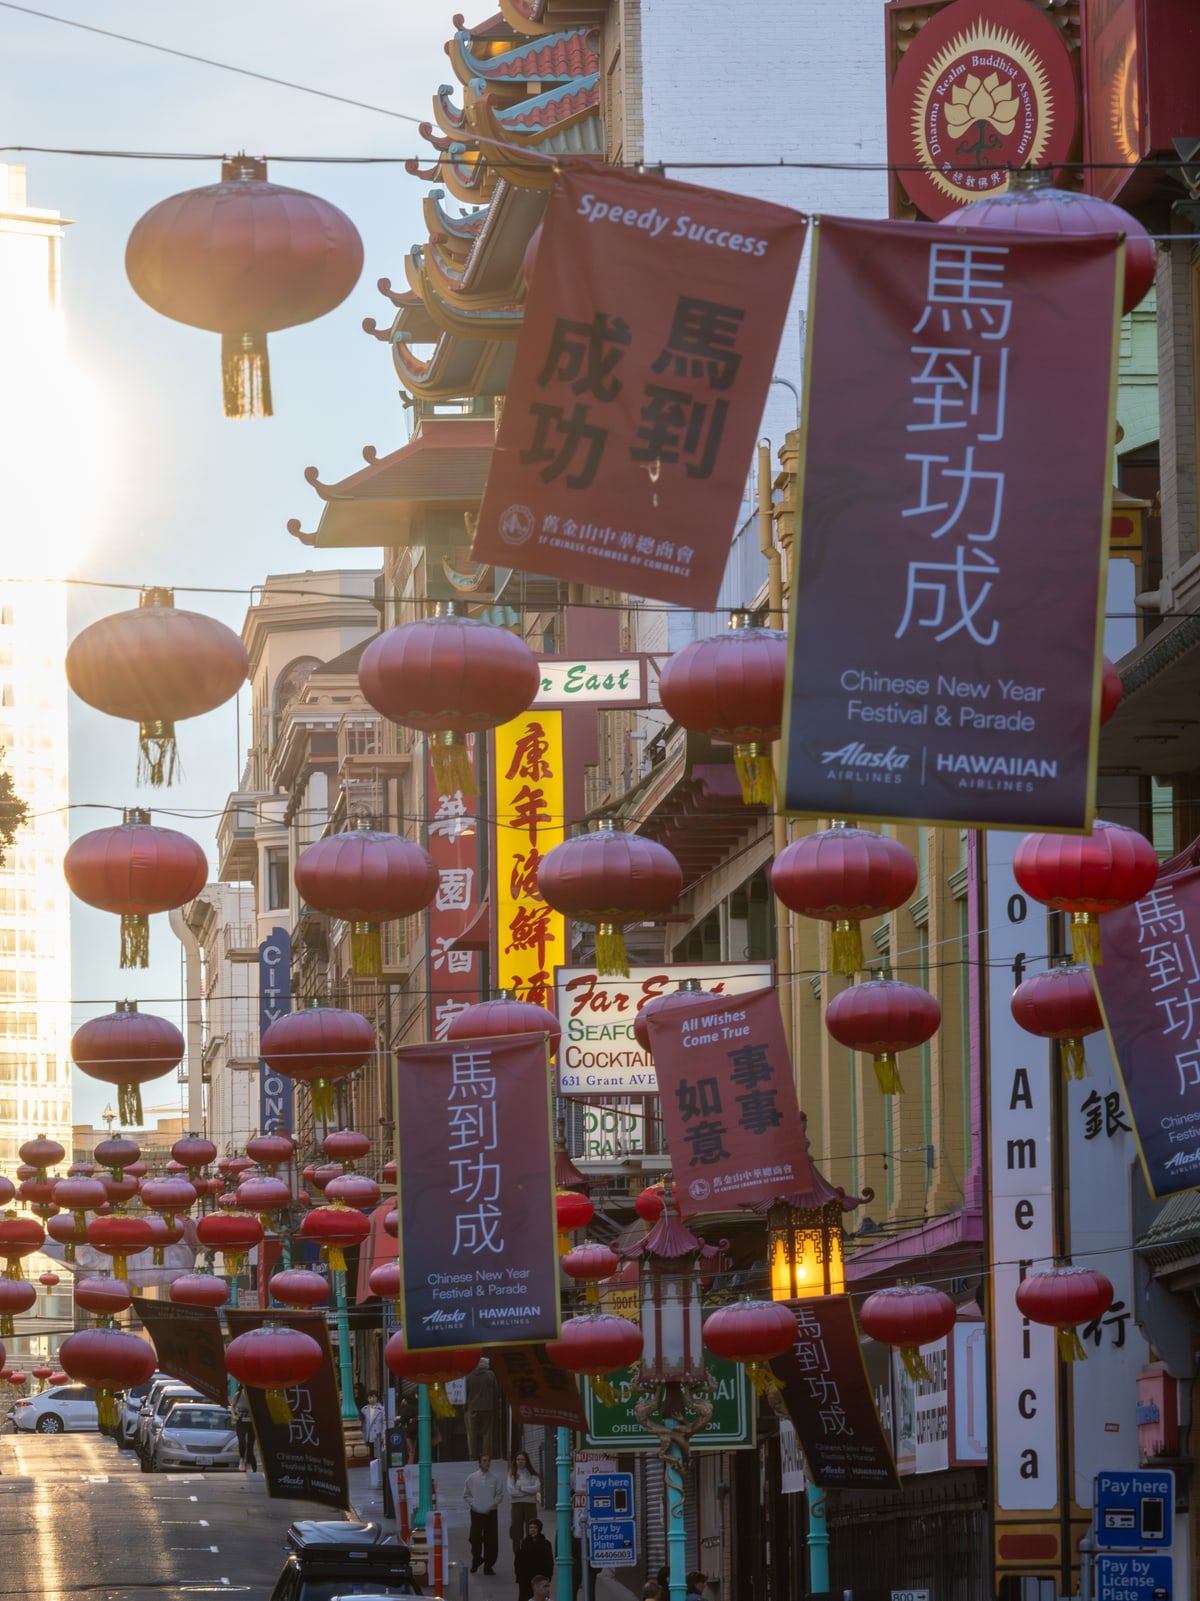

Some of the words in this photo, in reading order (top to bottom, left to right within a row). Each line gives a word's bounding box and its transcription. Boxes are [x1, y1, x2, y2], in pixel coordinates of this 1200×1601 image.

[936, 63, 966, 96] Realm
[971, 55, 1019, 80] Buddhist
[929, 103, 942, 156] Dharma
[1017, 82, 1035, 154] Association
[577, 193, 669, 237] Speedy
[673, 215, 769, 257] Success
[894, 242, 1012, 646] 馬到功成
[550, 538, 585, 552] CHINESE
[588, 546, 628, 562] CHAMBER
[644, 559, 691, 577] COMMERCE
[563, 664, 630, 693] East
[840, 669, 930, 697] Chinese
[937, 675, 989, 700] New
[997, 680, 1045, 703] Year
[847, 701, 929, 726] Festival
[935, 705, 952, 728] &
[960, 706, 1035, 733] Parade
[821, 741, 910, 770] Alaska
[937, 753, 1057, 779] HAWAIIAN
[827, 770, 902, 784] AIRLINES
[959, 777, 1034, 793] AIRLINES
[565, 974, 630, 1017] Far
[682, 1017, 698, 1034] All
[700, 1009, 746, 1029] Wishes
[683, 1032, 719, 1049] Come
[722, 1025, 750, 1041] True
[562, 1075, 580, 1086] 631
[586, 1075, 624, 1086] Grant
[629, 1074, 656, 1085] AVE
[447, 1051, 504, 1256] 馬到功成
[427, 1273, 473, 1285] Chinese
[475, 1270, 503, 1281] New
[506, 1268, 530, 1279] Year
[432, 1287, 473, 1300] Festival
[476, 1285, 485, 1296] &
[488, 1283, 527, 1295] Parade
[422, 1309, 466, 1324] Alaska
[479, 1306, 541, 1318] HAWAIIAN
[590, 1479, 607, 1488] Pay
[608, 1478, 629, 1487] here
[1101, 1479, 1131, 1494] Pay
[1133, 1479, 1168, 1493] here
[593, 1525, 608, 1533] Pay
[610, 1524, 621, 1533] by
[593, 1533, 624, 1541] License
[594, 1541, 615, 1549] Plate
[1102, 1560, 1127, 1575] Pay
[1133, 1560, 1150, 1575] by
[1102, 1575, 1155, 1587] License
[1102, 1588, 1139, 1601] Plate
